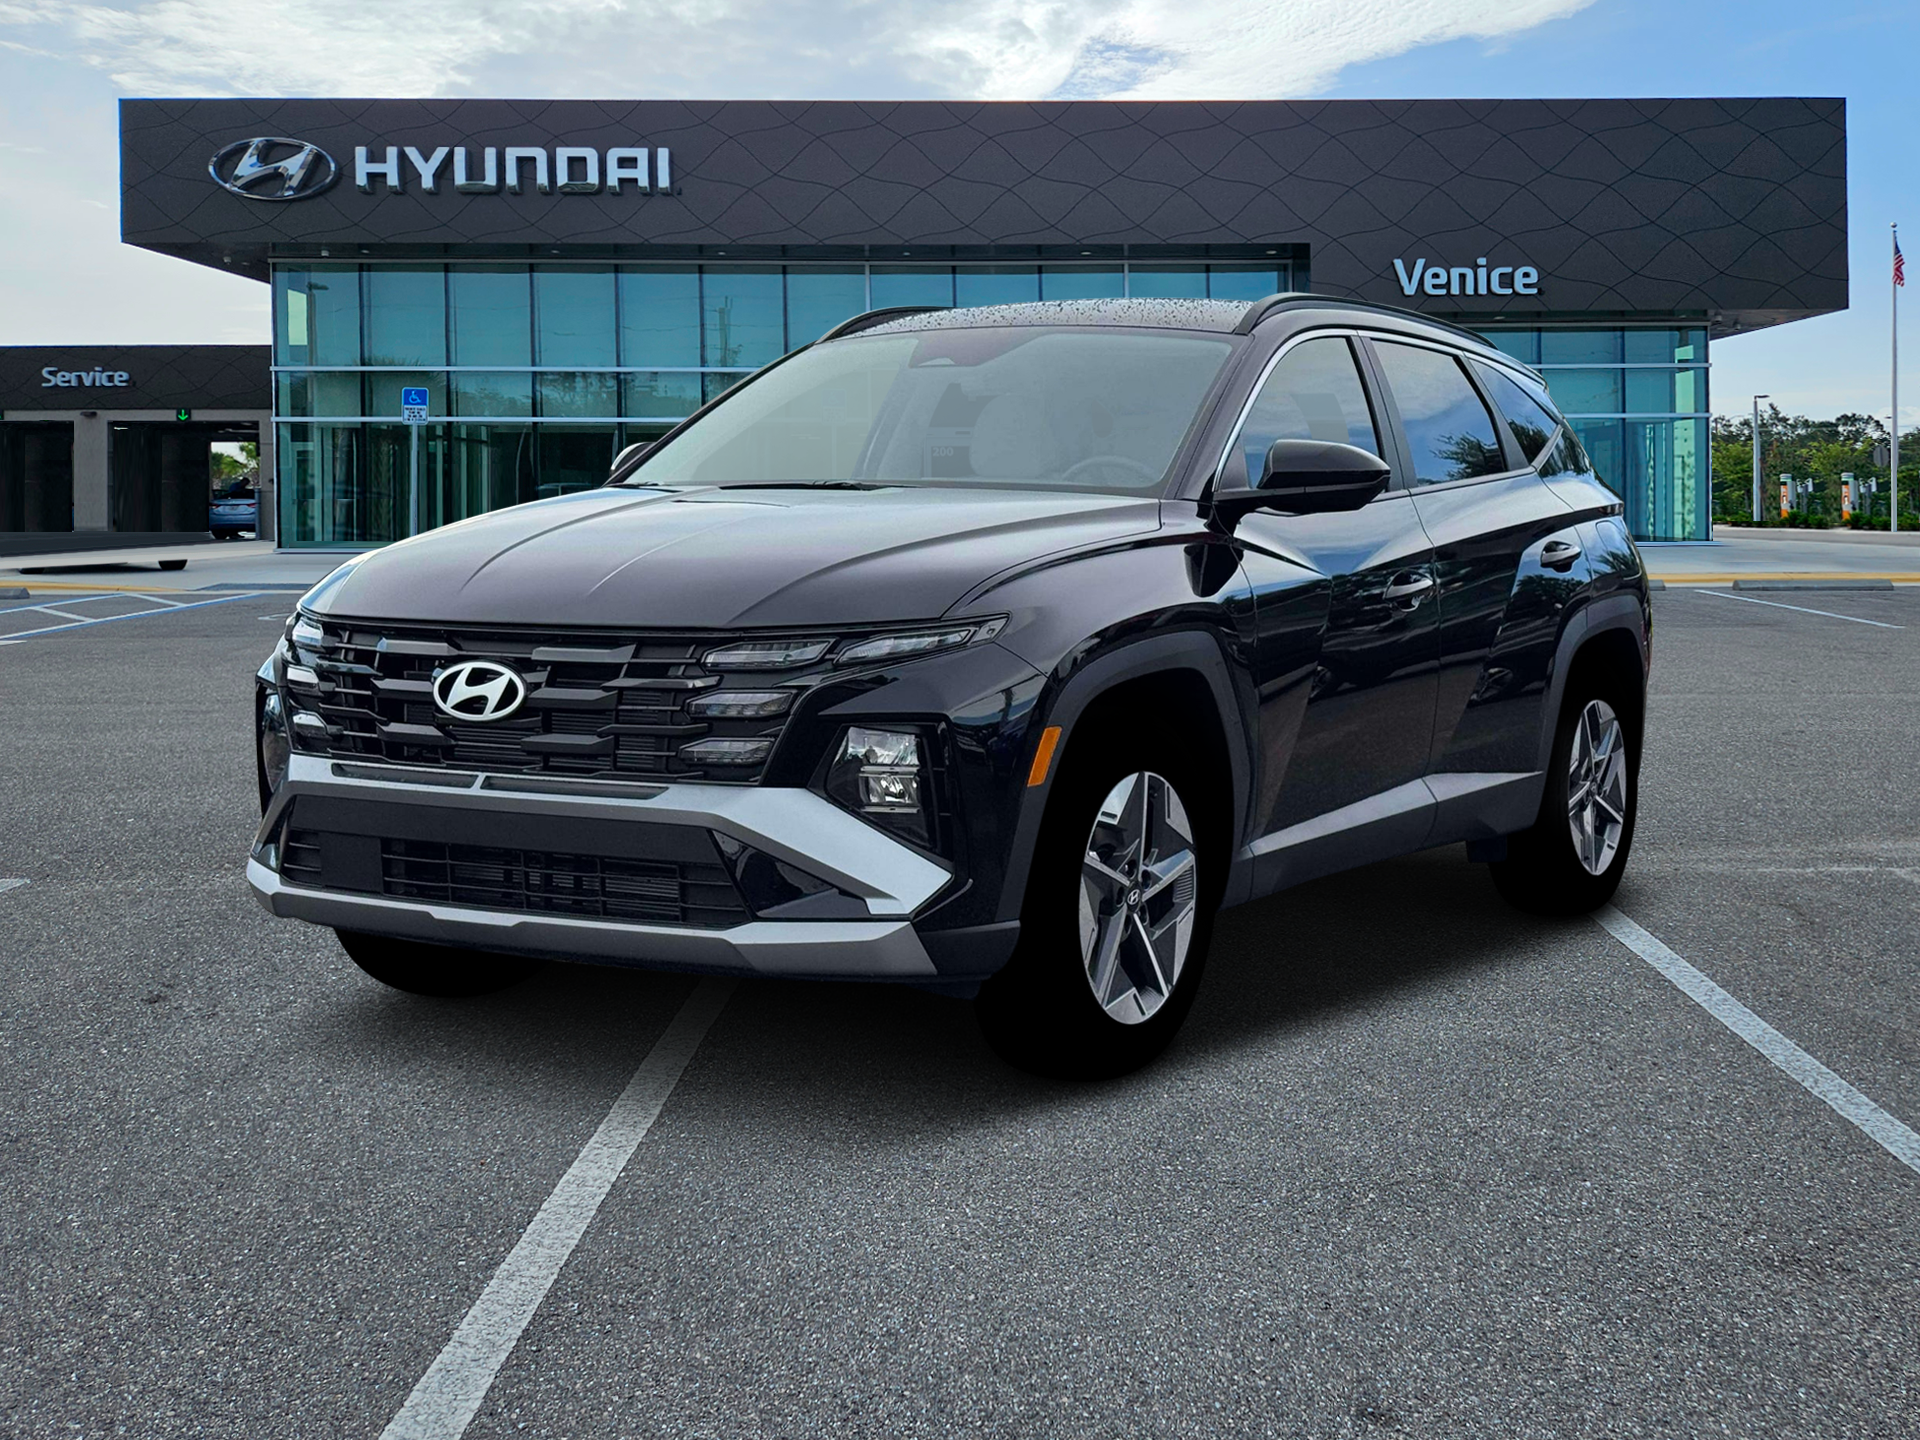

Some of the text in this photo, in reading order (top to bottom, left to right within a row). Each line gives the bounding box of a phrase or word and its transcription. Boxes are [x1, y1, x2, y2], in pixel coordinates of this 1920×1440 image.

[354, 146, 670, 194] HYUNDAI
[1393, 257, 1539, 296] Venice
[41, 366, 129, 387] Service
[932, 446, 954, 457] 200
